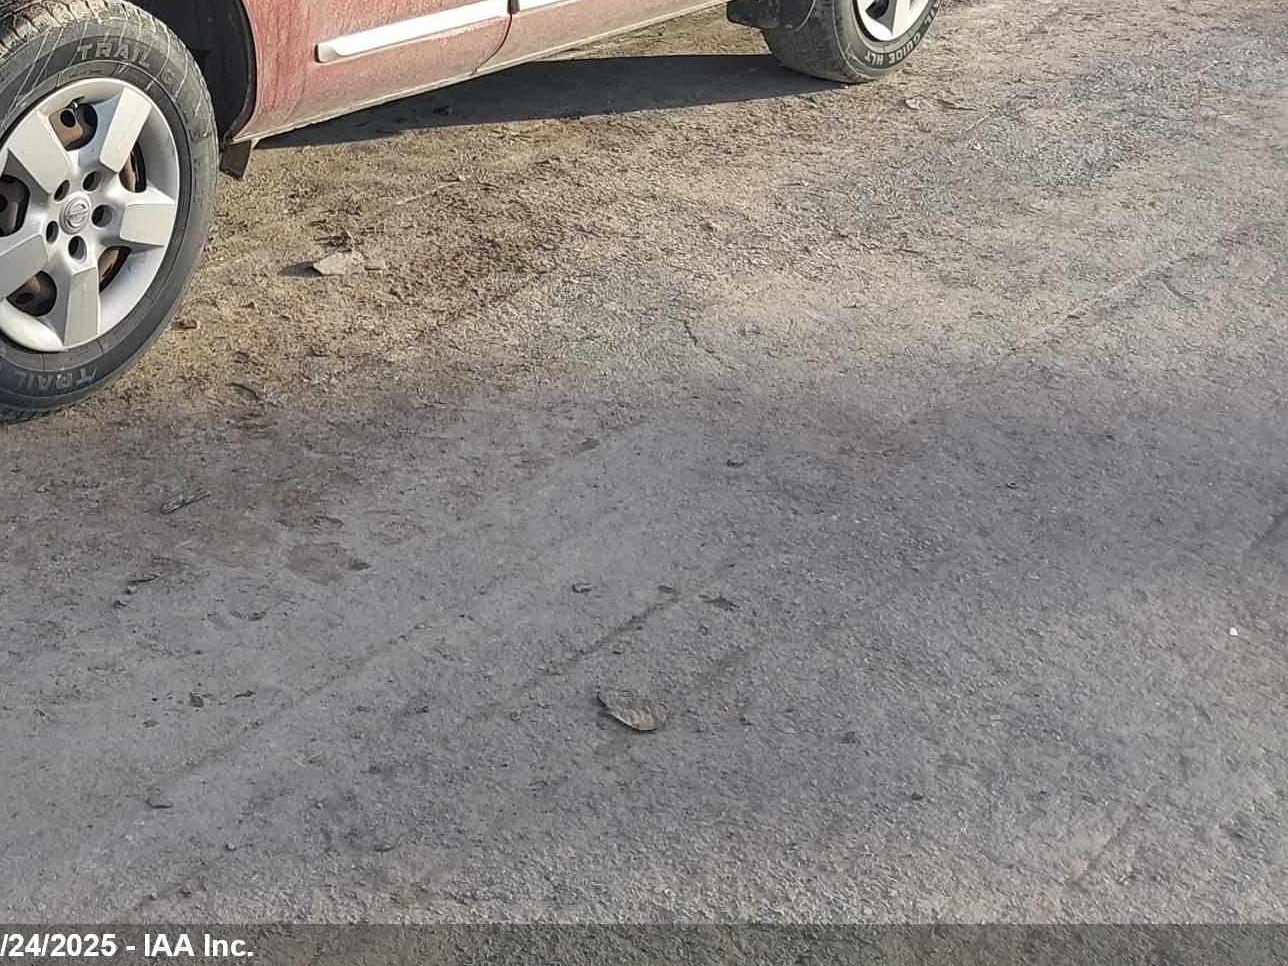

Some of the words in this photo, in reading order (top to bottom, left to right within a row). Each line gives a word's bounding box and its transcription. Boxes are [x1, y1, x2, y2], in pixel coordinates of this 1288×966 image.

[76, 41, 152, 69] TRAIL
[864, 49, 884, 66] HLT
[888, 32, 921, 65] GUIDE
